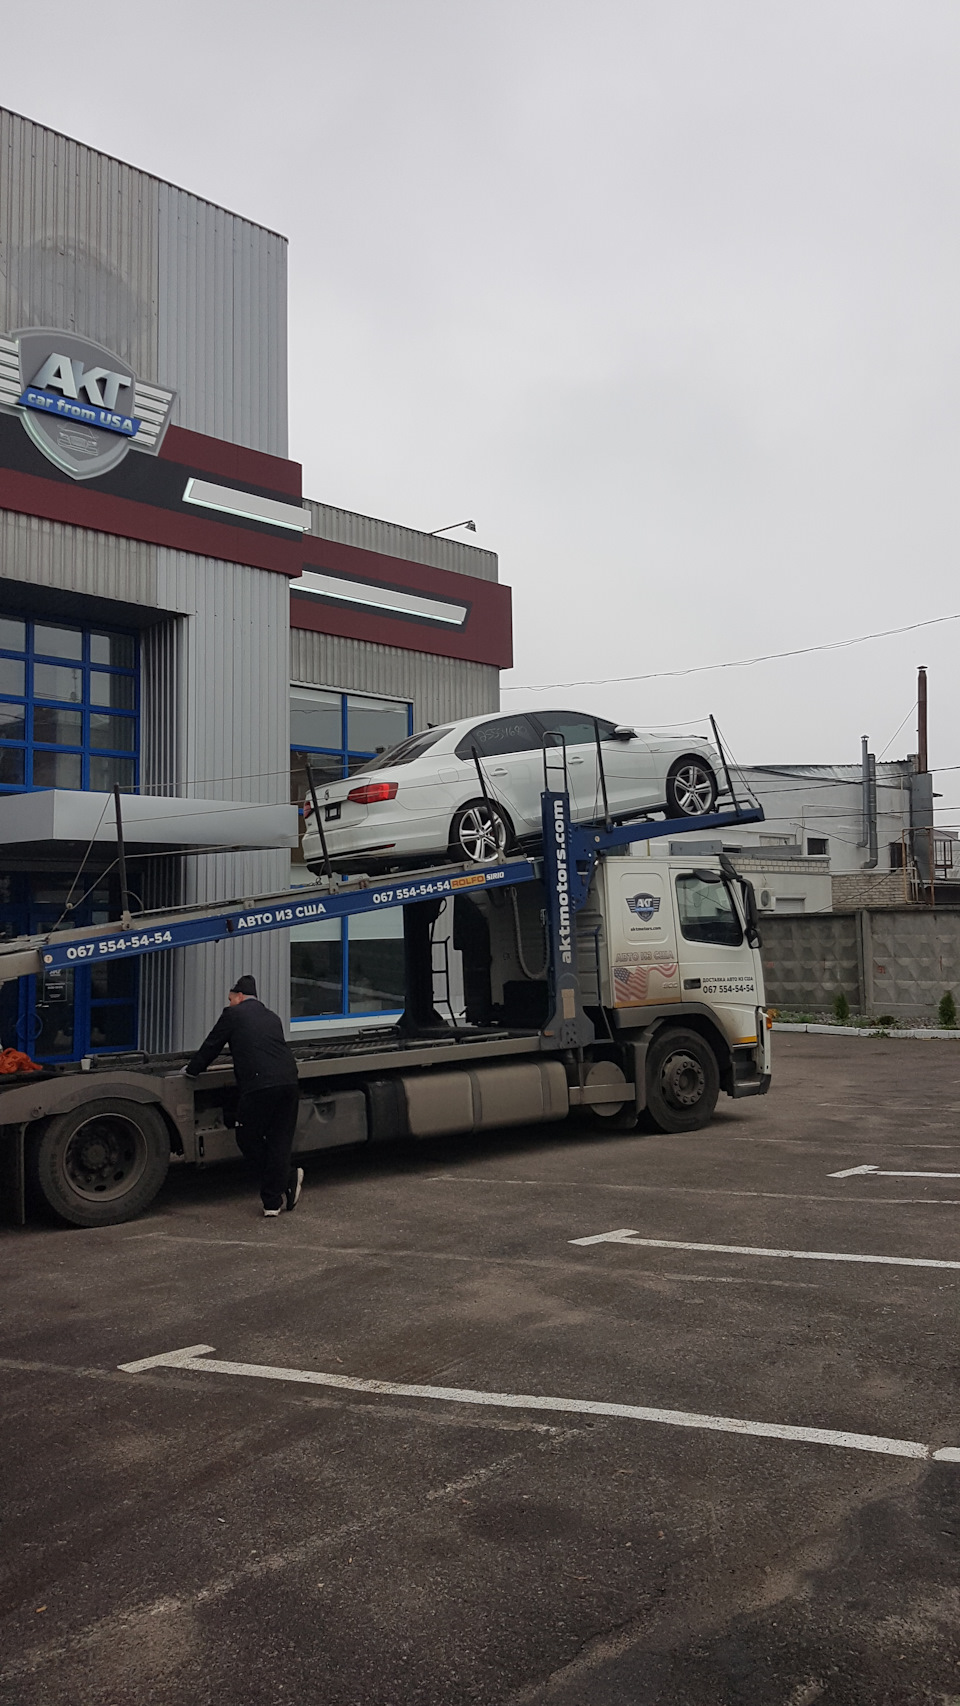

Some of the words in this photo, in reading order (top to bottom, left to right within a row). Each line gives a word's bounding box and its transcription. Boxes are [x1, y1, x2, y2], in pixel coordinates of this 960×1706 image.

[29, 352, 132, 411] AKT
[27, 392, 54, 408] car
[56, 399, 96, 421] from
[99, 411, 134, 433] USA
[372, 891, 394, 904] 067
[396, 879, 451, 900] 554-54-54
[451, 875, 485, 888] ROLFO
[553, 799, 573, 964] aktmotors.com
[237, 912, 273, 929] АВТО
[275, 908, 293, 921] ИЗ
[295, 903, 327, 918] США
[636, 898, 653, 908] AKT
[66, 943, 95, 960] 067
[98, 930, 173, 954] 554-54-54
[702, 985, 717, 994] 067
[718, 984, 755, 993] 554-54-54
